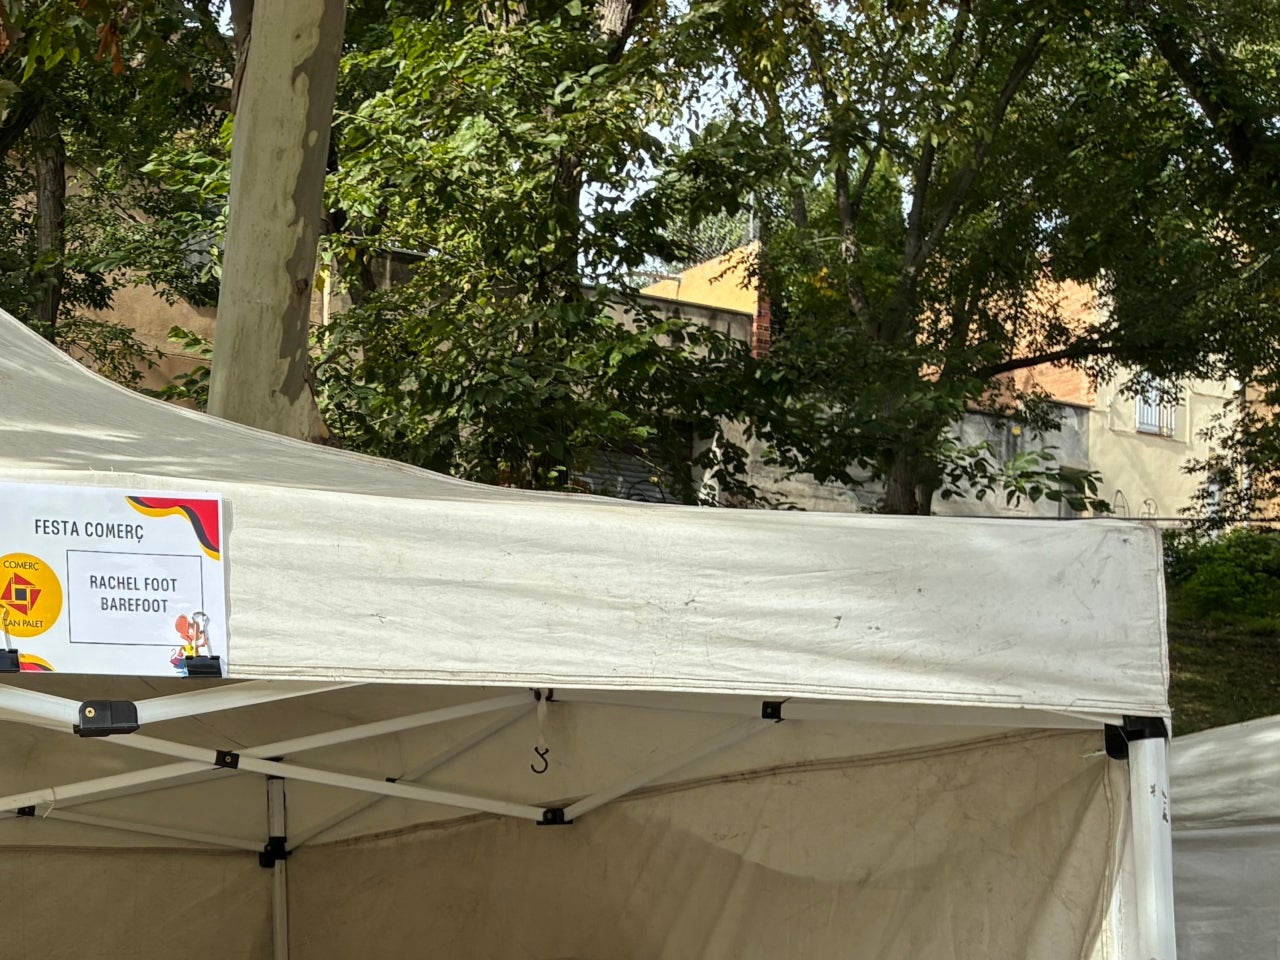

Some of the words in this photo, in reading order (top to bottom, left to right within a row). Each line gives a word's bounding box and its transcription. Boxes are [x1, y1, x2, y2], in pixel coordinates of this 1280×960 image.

[34, 519, 80, 537] FESTA
[84, 522, 144, 544] COMERÇ
[3, 560, 40, 572] COMERÇ
[90, 575, 140, 592] RACHEL
[144, 577, 178, 592] FOOT
[100, 597, 168, 612] BAREFOOT
[22, 619, 44, 628] PALET
